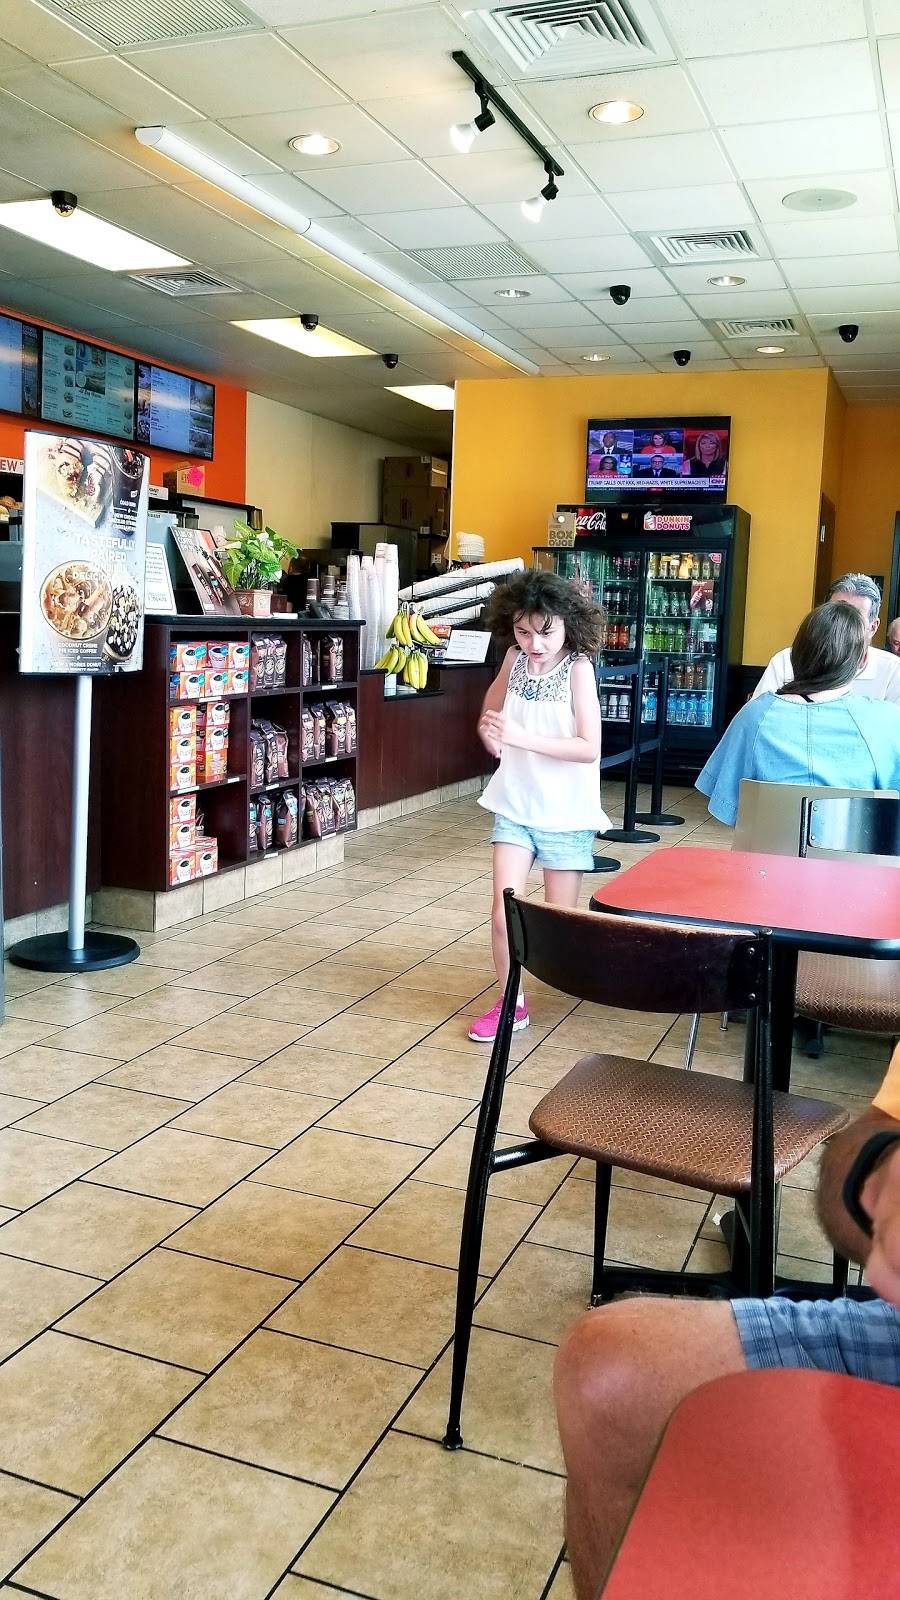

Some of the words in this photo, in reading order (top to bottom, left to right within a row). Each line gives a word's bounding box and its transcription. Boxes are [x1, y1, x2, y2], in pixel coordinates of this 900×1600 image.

[0, 459, 18, 471] EW
[656, 515, 693, 523] DUNKIN'
[656, 522, 691, 531] DONUTS
[549, 530, 573, 540] BOX
